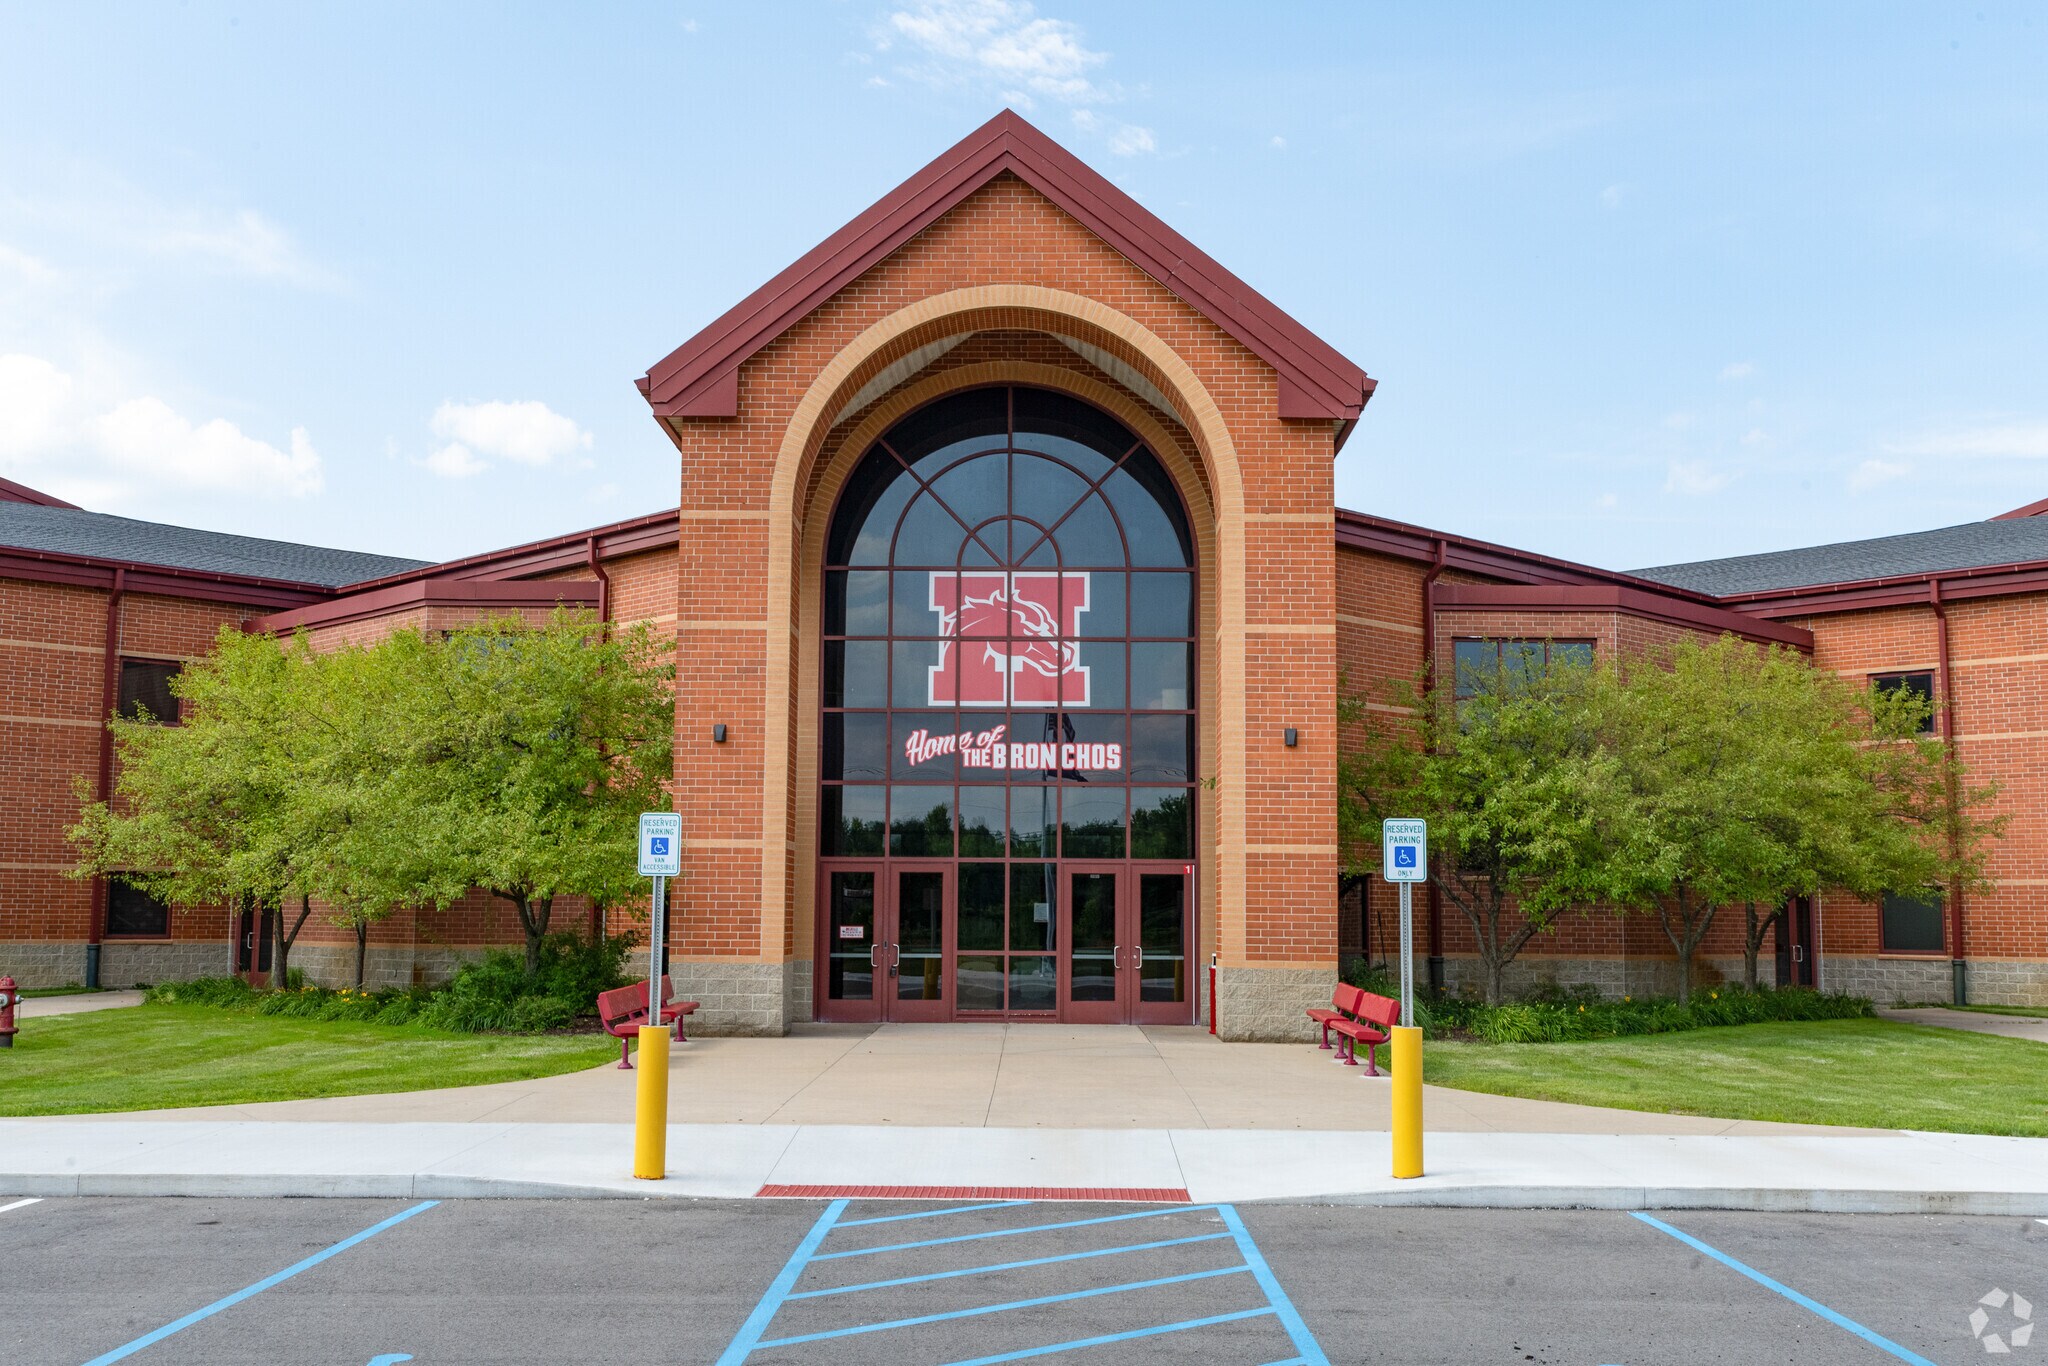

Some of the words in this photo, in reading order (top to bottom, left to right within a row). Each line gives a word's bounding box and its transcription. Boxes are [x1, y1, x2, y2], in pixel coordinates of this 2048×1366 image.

[905, 728, 974, 767] Home
[976, 724, 1006, 751] of
[962, 748, 992, 767] THE
[992, 743, 1122, 769] BRONCHOS
[643, 819, 678, 827] RESERVED
[1387, 825, 1423, 833] RESERVED
[1389, 836, 1421, 844] PARKING
